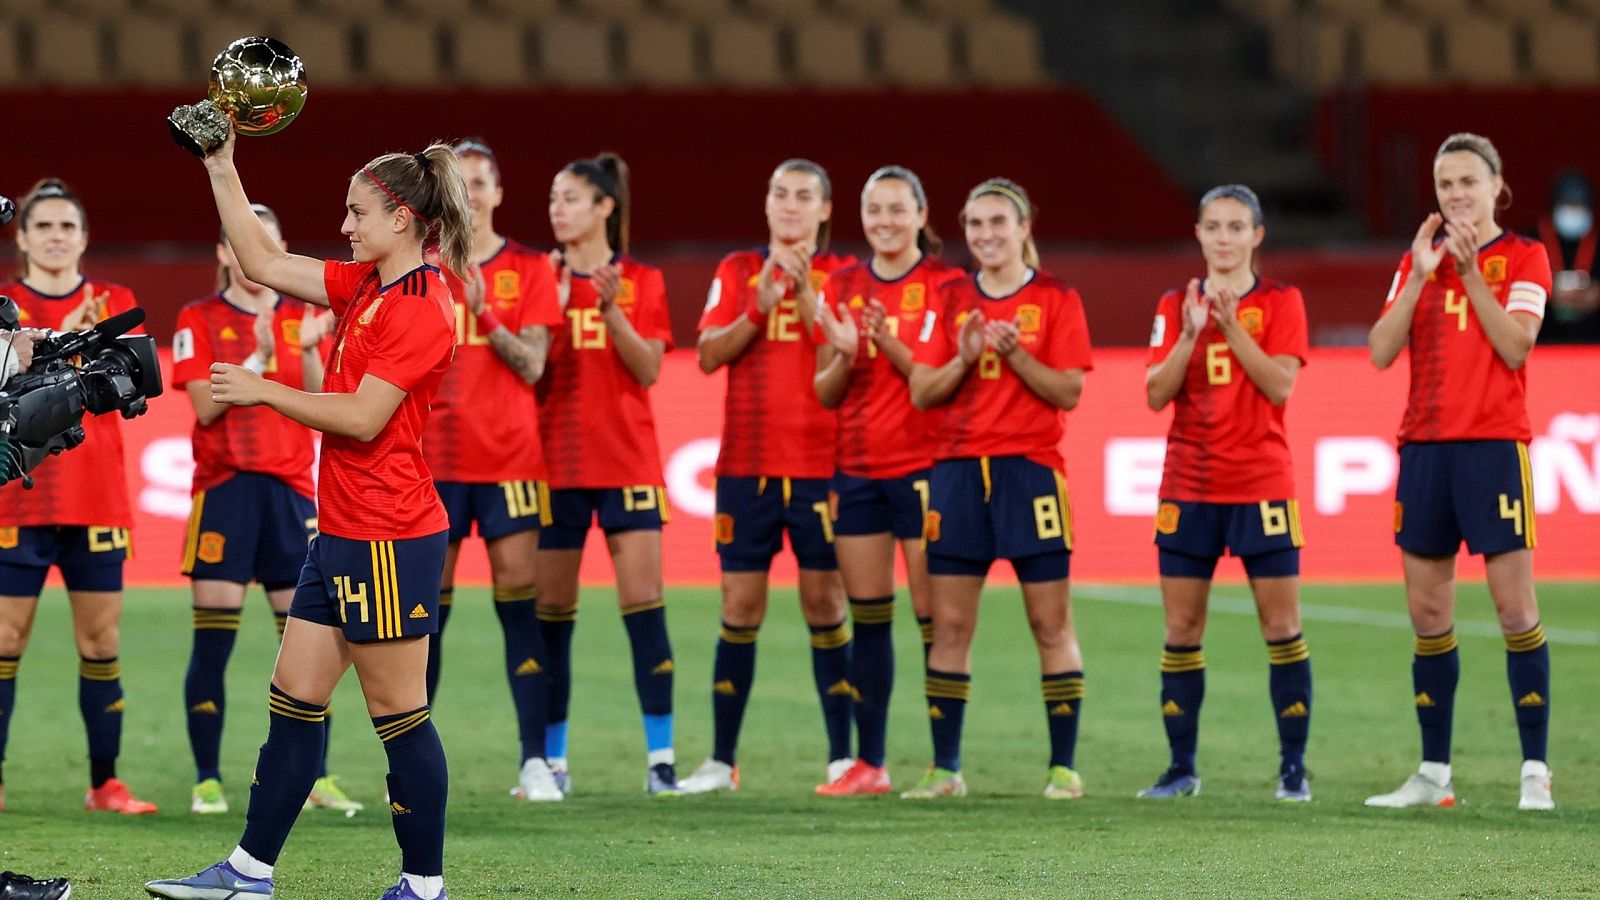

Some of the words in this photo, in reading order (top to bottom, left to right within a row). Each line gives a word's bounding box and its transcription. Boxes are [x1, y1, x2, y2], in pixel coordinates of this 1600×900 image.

[566, 308, 606, 349] 15
[766, 300, 801, 341] 12
[1445, 289, 1468, 331] 4
[1207, 343, 1231, 385] 6
[498, 479, 541, 518] 10
[1033, 496, 1062, 539] 8
[1259, 500, 1288, 536] 6
[1499, 494, 1523, 536] 4
[333, 575, 369, 623] 14
